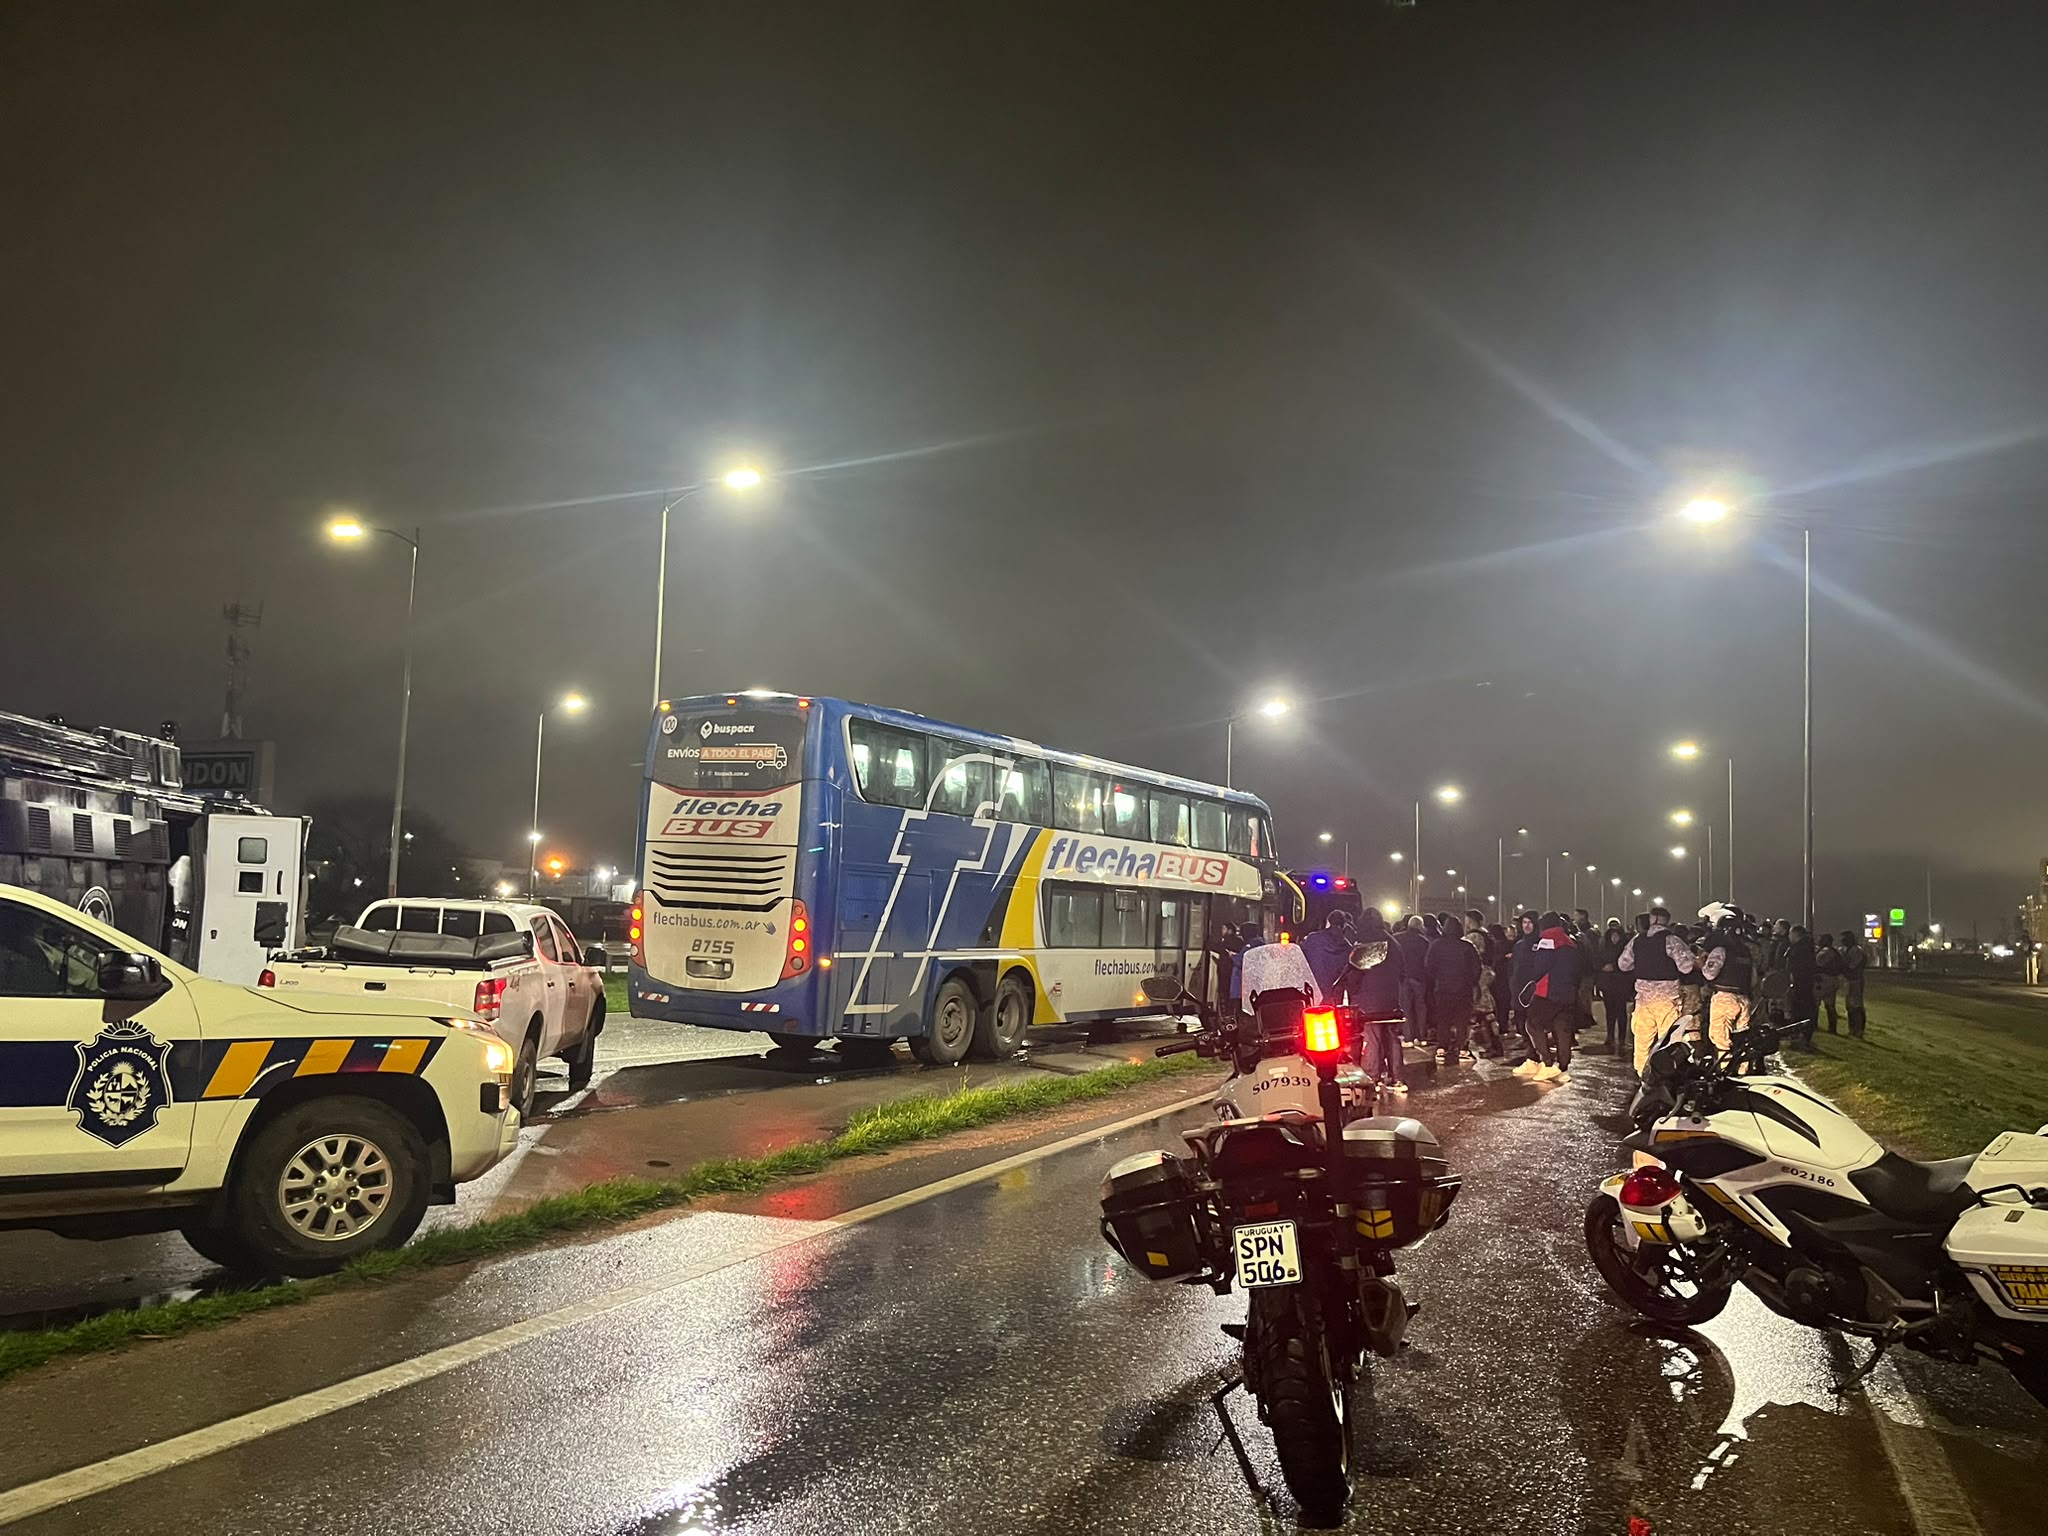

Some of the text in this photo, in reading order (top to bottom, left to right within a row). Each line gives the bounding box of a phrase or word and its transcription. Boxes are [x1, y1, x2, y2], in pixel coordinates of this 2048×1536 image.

[713, 724, 755, 735] buspack
[667, 747, 774, 758] ENVÍOS A TODO EL PAÍS
[672, 799, 783, 816] flecha
[664, 819, 763, 836] BUS
[653, 912, 761, 930] flechabus.com.ar
[692, 939, 735, 954] 8755
[87, 1047, 158, 1072] POLICIA NACIONAL
[1252, 1076, 1311, 1095] S07939
[1244, 1225, 1285, 1236] URUGUAY
[1240, 1234, 1284, 1259] SPN
[1243, 1259, 1286, 1283] 506
